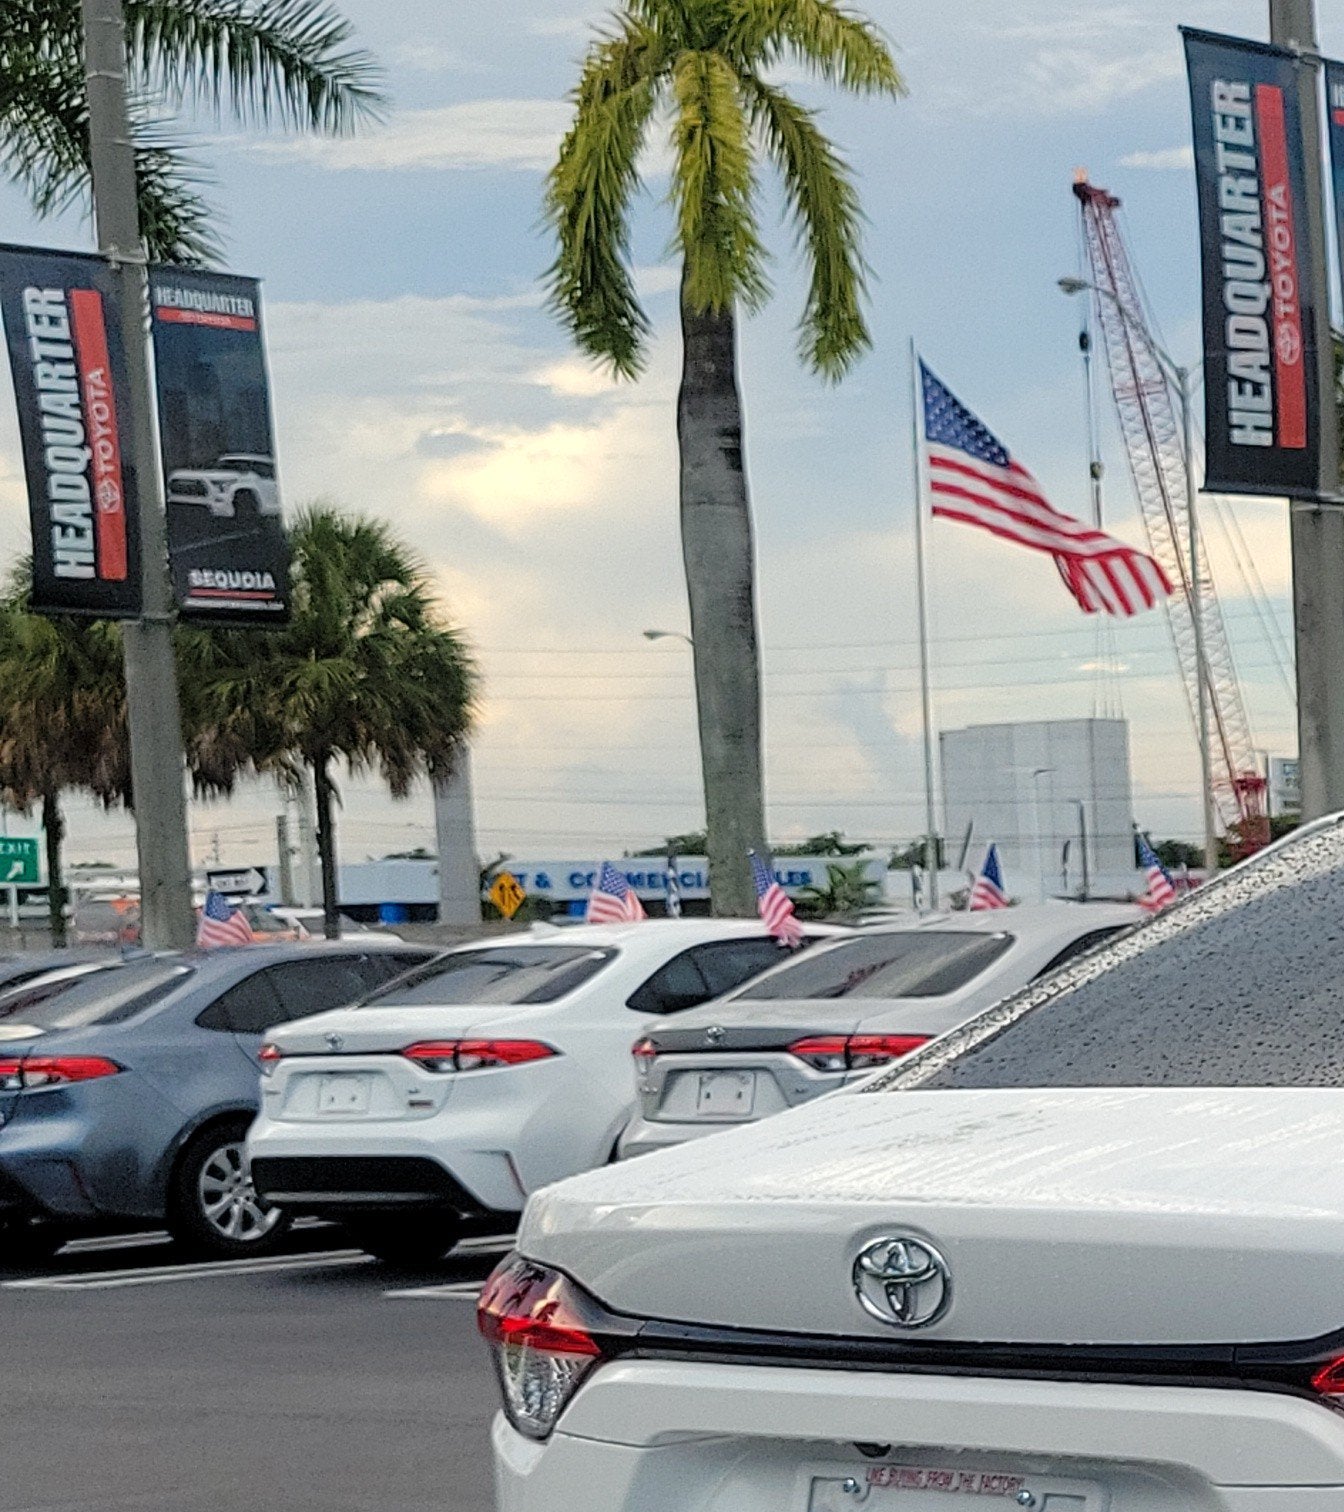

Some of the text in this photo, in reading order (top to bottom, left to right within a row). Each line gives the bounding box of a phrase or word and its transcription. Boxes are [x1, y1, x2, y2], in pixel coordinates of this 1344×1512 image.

[153, 286, 255, 317] HEADQUARTER
[1211, 79, 1273, 447] HEADQUARTER
[1268, 185, 1295, 319] TOYOTA
[24, 287, 96, 579] HEADQUARTER
[87, 368, 118, 474] TOYOTA
[188, 568, 276, 589] SEQUOIA
[928, 1470, 955, 1488] FROM
[958, 1472, 976, 1489] THE
